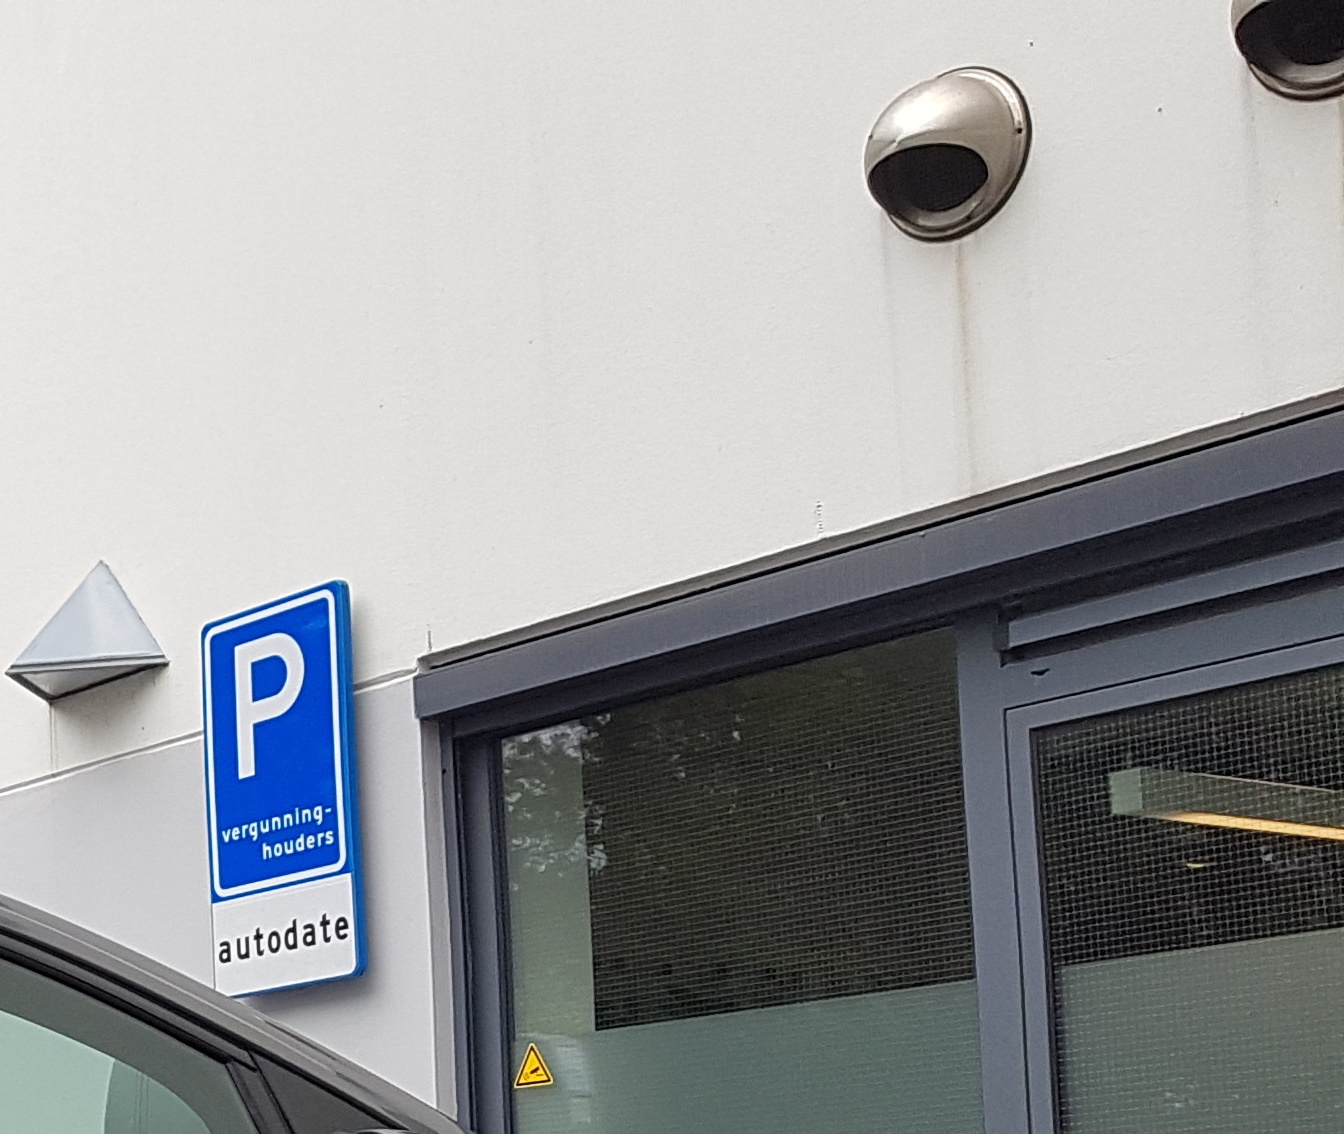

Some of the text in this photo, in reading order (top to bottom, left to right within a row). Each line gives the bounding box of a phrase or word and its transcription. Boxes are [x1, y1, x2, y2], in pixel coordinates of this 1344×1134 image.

[233, 632, 306, 780] P
[221, 805, 333, 843] vergunning-
[261, 830, 335, 861] houders
[218, 912, 350, 964] autodate
